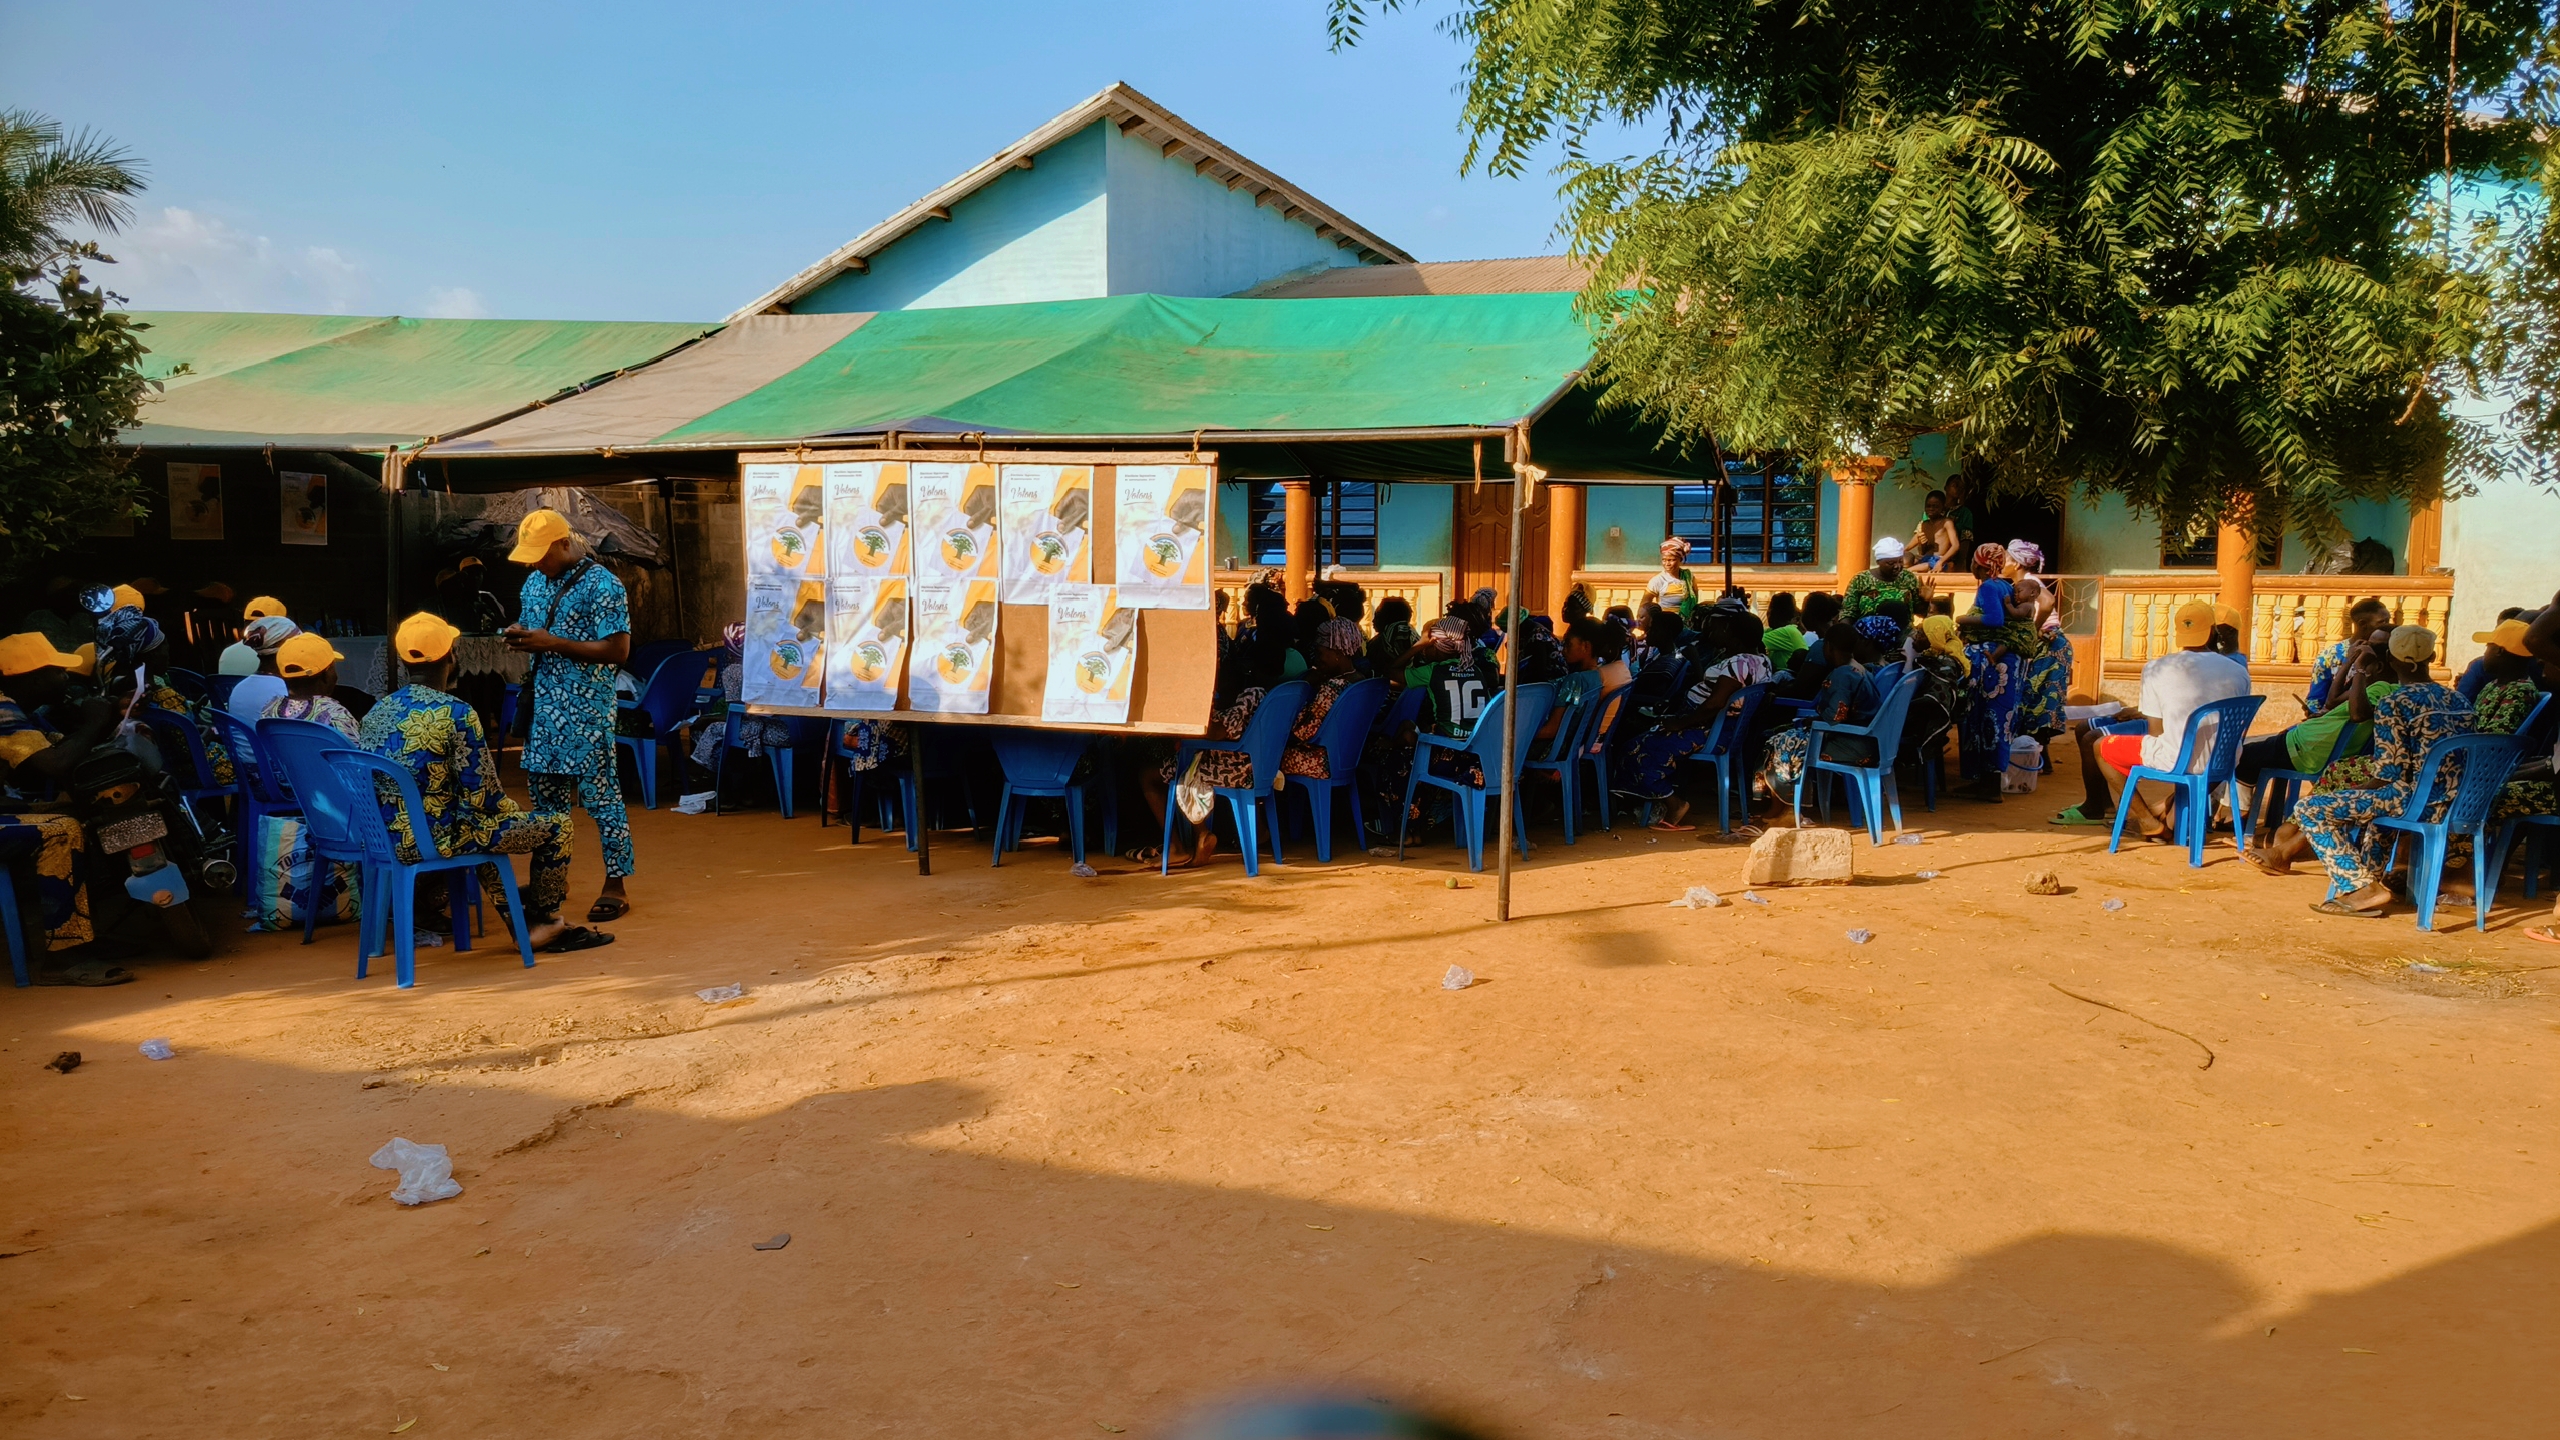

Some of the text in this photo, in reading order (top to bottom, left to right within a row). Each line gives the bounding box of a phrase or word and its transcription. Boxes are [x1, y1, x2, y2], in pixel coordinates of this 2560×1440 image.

[752, 484, 777, 497] Votons
[834, 483, 860, 496] Votons
[920, 485, 947, 498] Votons
[1010, 486, 1038, 499] Votons
[1124, 488, 1153, 501] Votons
[755, 596, 780, 609] Votons
[835, 598, 860, 612] Votons
[921, 598, 948, 612] Votons
[1057, 606, 1087, 620] Votons
[277, 851, 300, 871] TOP
